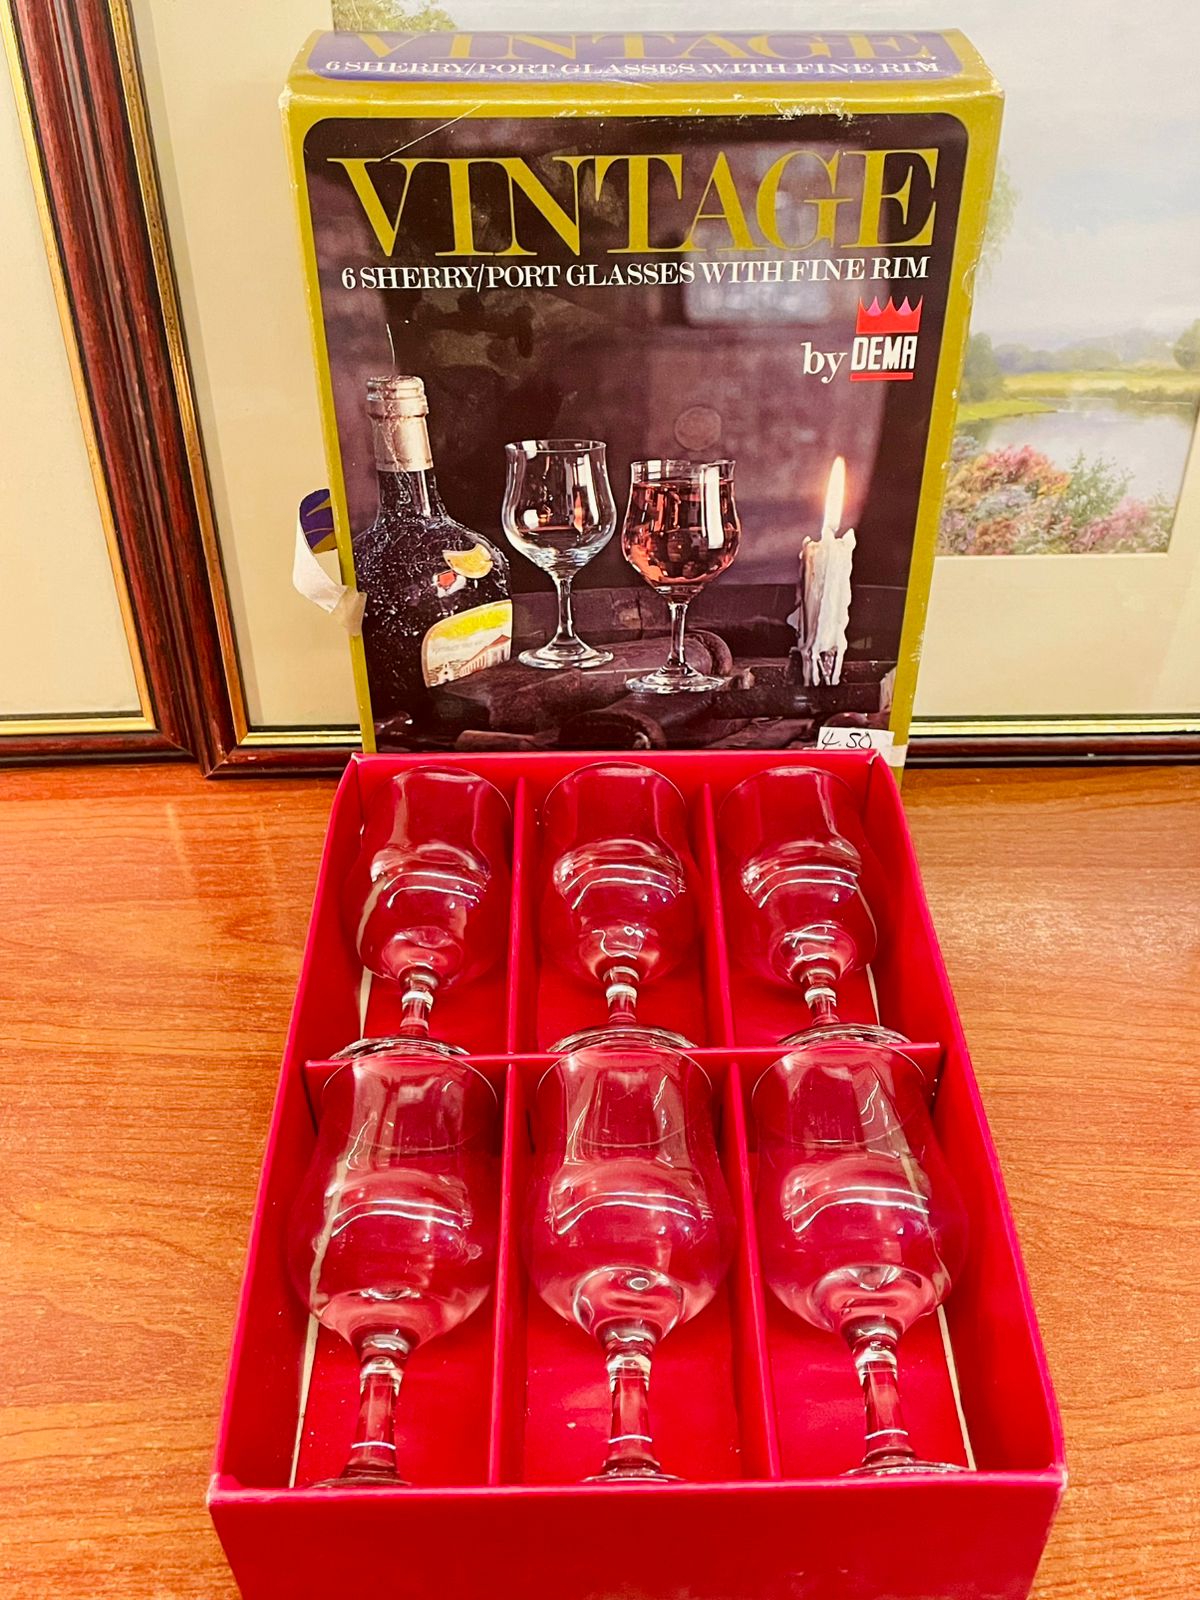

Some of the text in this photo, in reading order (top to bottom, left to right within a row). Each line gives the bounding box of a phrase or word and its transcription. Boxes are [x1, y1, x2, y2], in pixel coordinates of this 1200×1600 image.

[346, 33, 932, 60] VINTAGE
[325, 60, 940, 75] 6 SHERRY/PORT GLASSES WITH FINE RIM
[327, 147, 938, 258] VINTAGE
[341, 256, 931, 293] 6 SHERRY/PORT GLASSES WITH FINE RIM
[800, 335, 918, 384] by DEMA
[821, 730, 873, 750] 4.50
